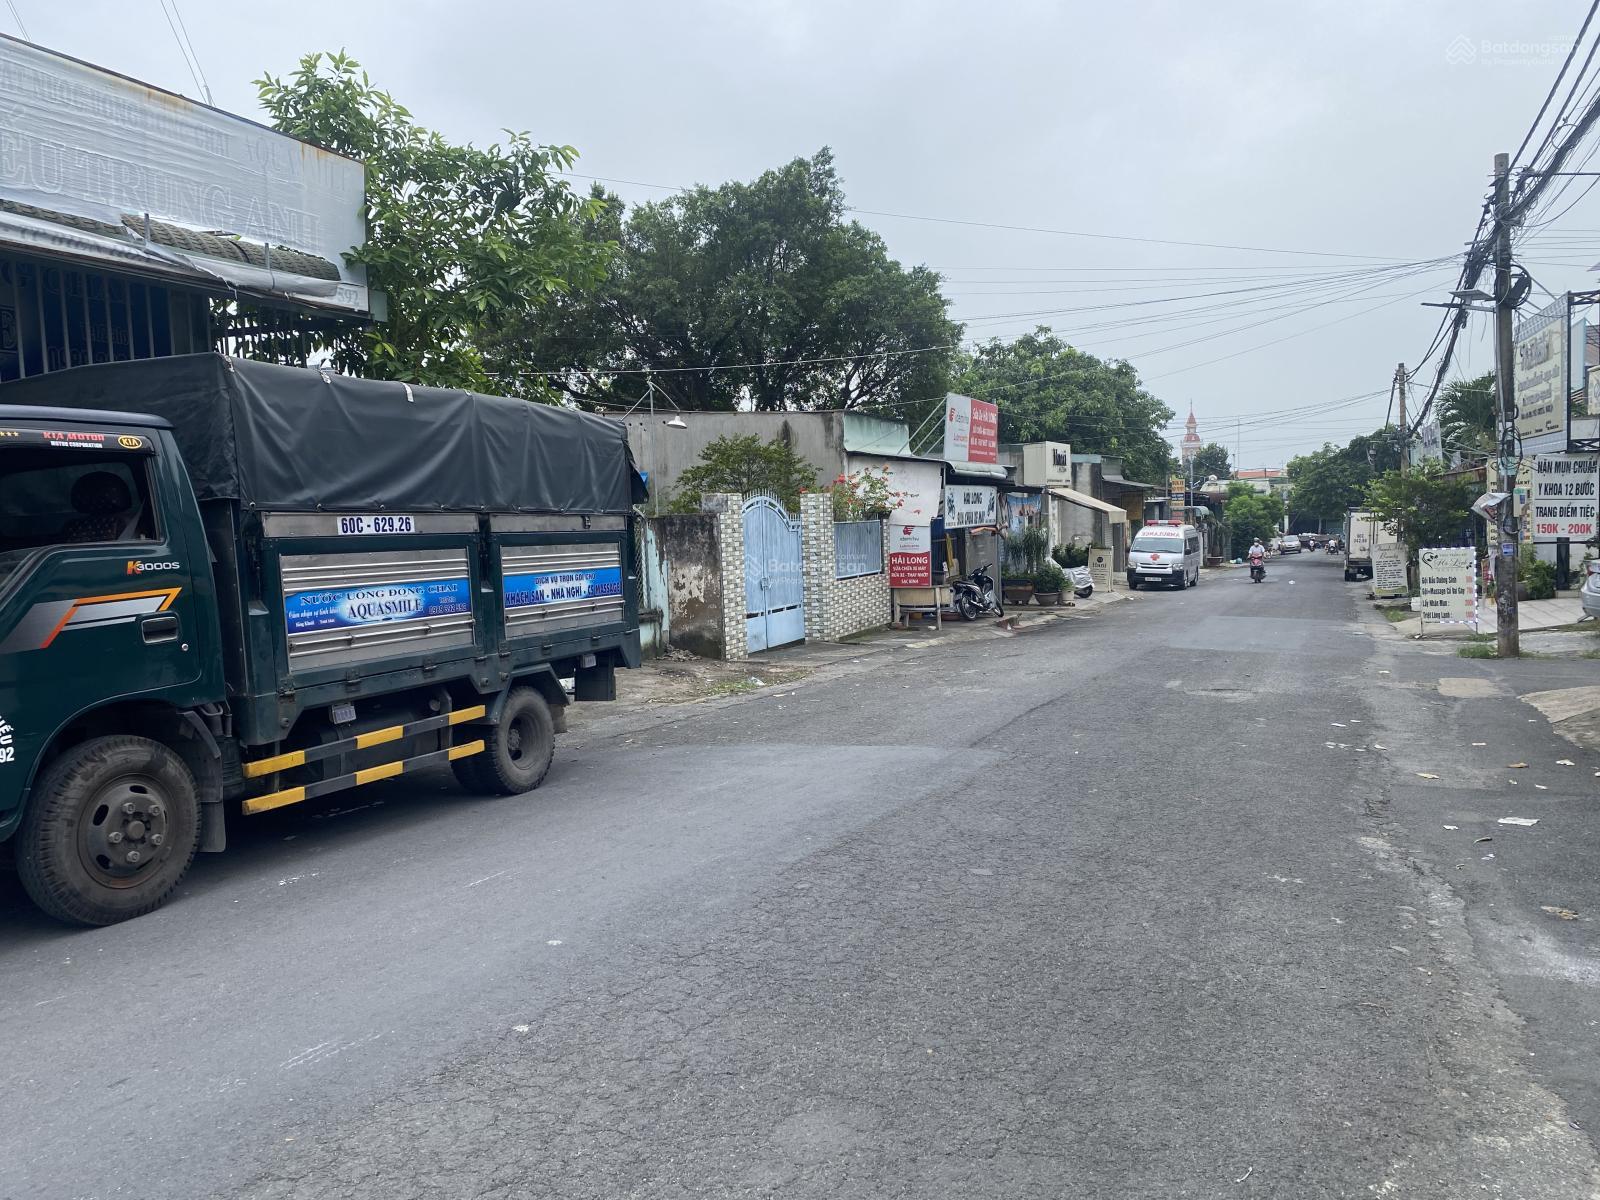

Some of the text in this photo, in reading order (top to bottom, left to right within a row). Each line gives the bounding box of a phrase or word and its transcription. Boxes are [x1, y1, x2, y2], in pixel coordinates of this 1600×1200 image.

[42, 431, 64, 441] KIA
[120, 437, 140, 448] KIA
[1538, 480, 1595, 496] Y KHOA 12 BƯỚC
[1536, 502, 1595, 520] TRANG ĐIỂM TIỆC
[341, 517, 363, 534] 60C
[374, 516, 411, 533] 629.26
[1536, 523, 1559, 534] 150K
[1568, 523, 1592, 534] 200K
[127, 560, 181, 575] K3000S
[906, 556, 928, 564] LONG
[348, 598, 424, 620] AQUASMILE
